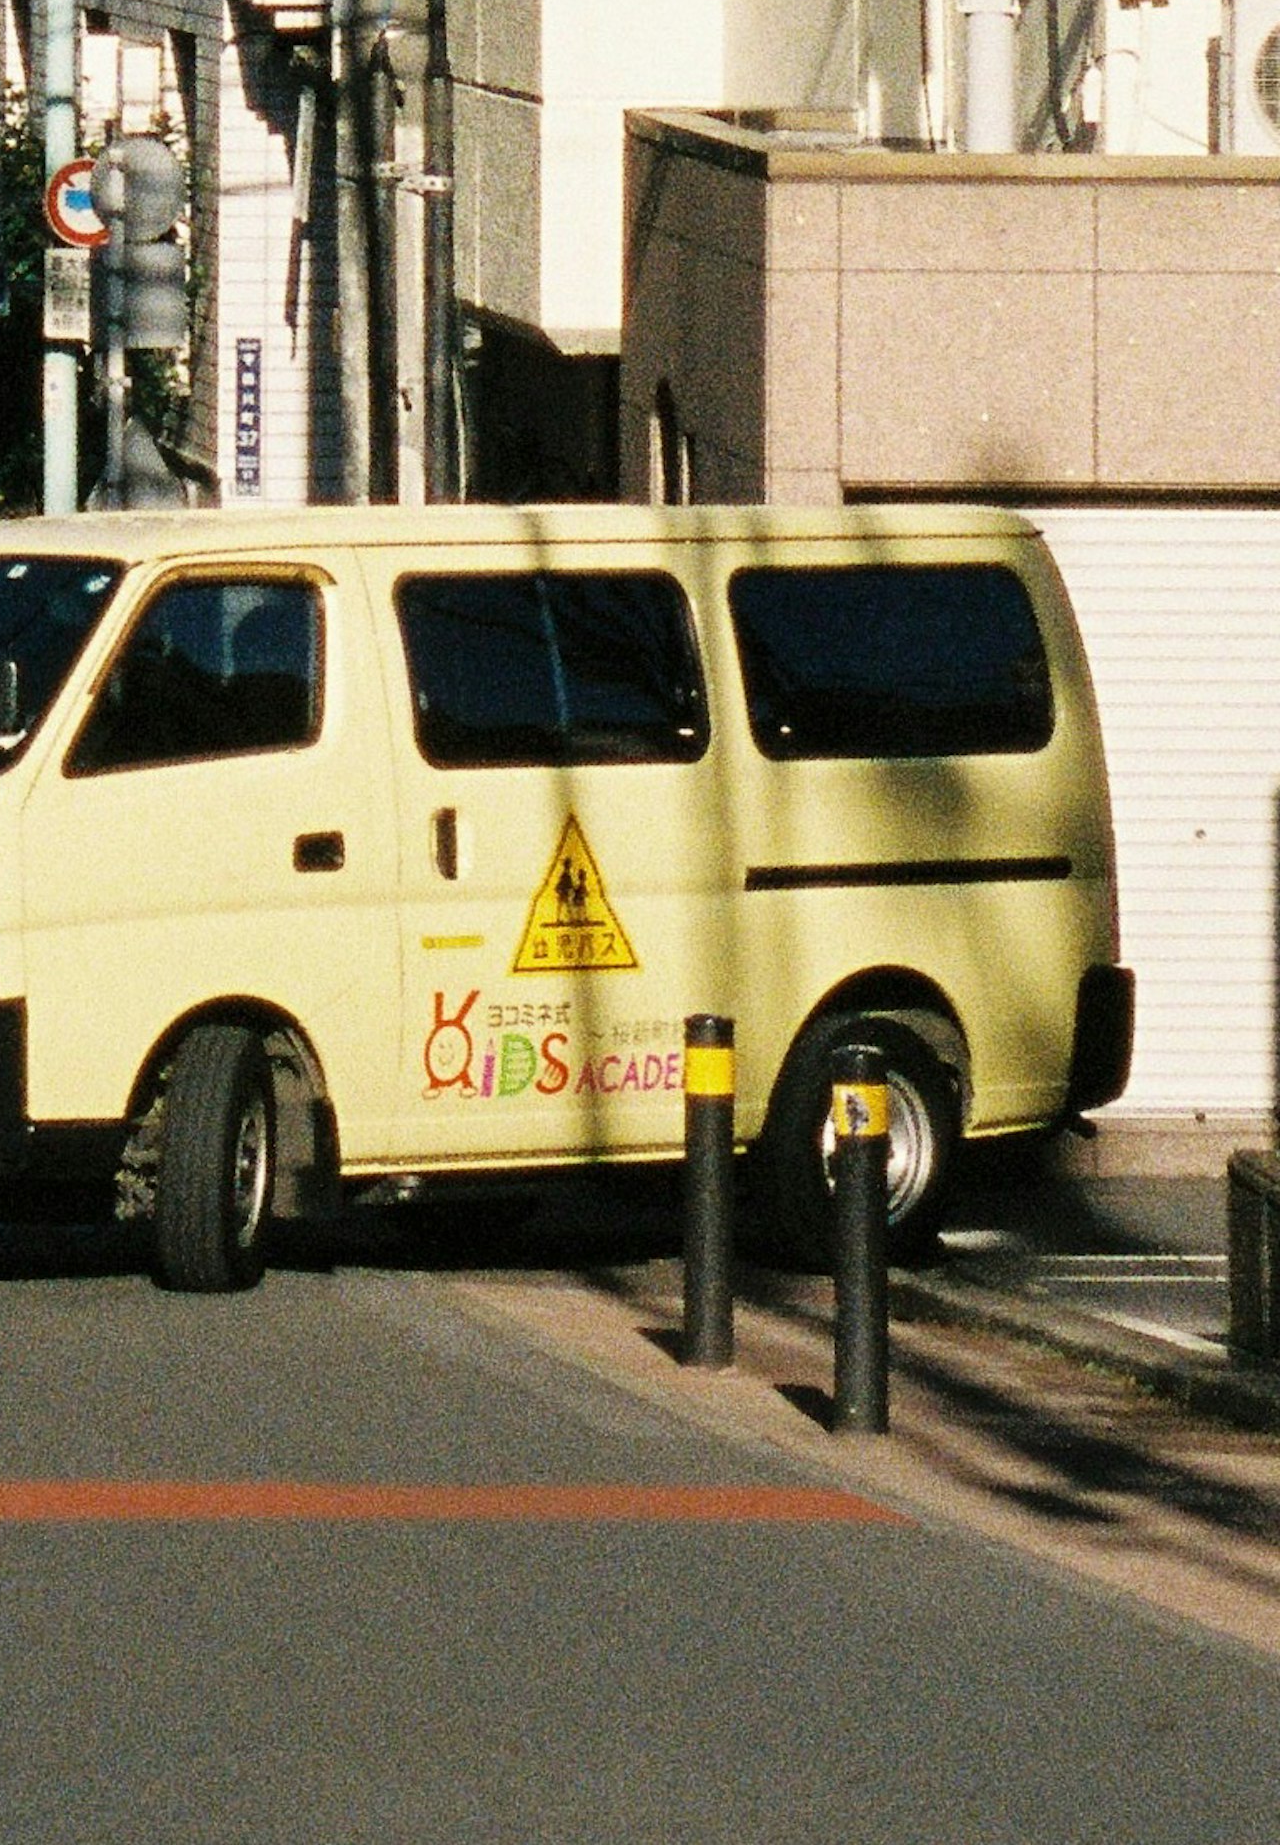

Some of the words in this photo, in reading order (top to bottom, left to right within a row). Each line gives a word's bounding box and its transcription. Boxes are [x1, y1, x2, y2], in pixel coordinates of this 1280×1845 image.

[487, 1001, 571, 1029] ヨコミネ式
[574, 1052, 685, 1095] ACADE
